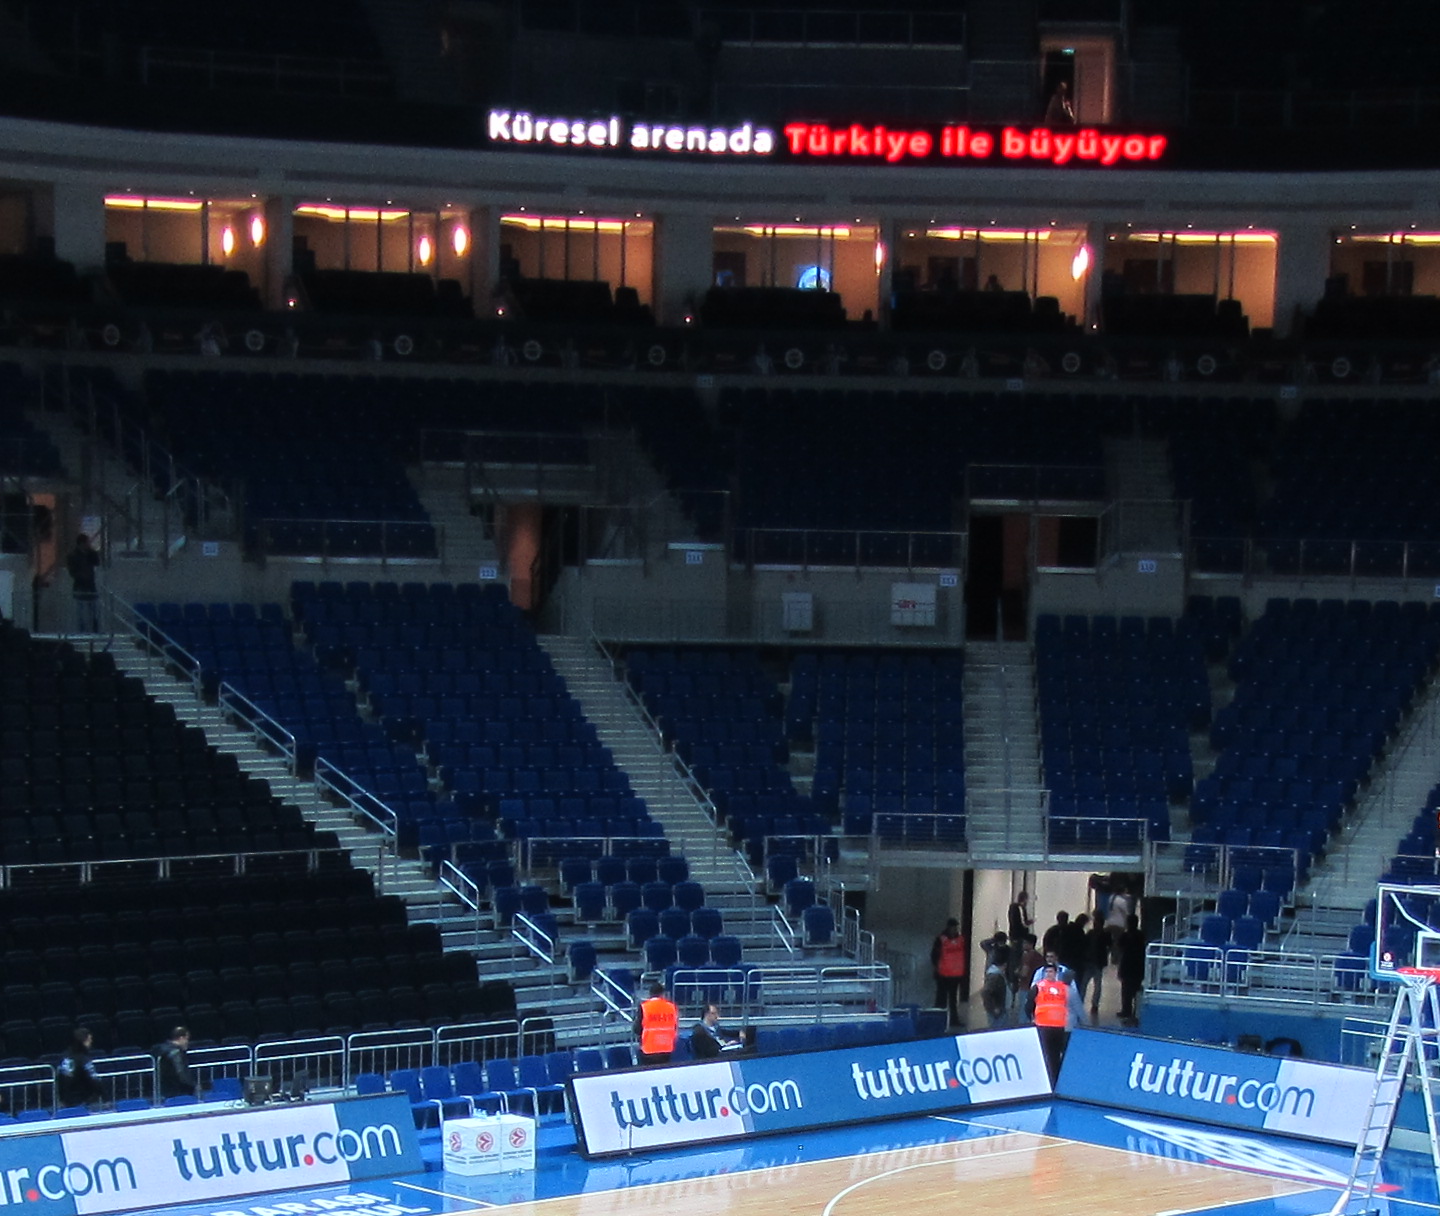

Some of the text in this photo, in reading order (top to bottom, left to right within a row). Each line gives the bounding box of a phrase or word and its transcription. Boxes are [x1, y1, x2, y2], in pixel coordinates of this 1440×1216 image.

[488, 111, 1167, 165] Küresel arenada Türkiye ile büyüyor
[610, 1048, 1023, 1130] tuttur.com tuttur.com
[1127, 1051, 1316, 1118] tuttur.com
[172, 1122, 402, 1181] tuttur.com
